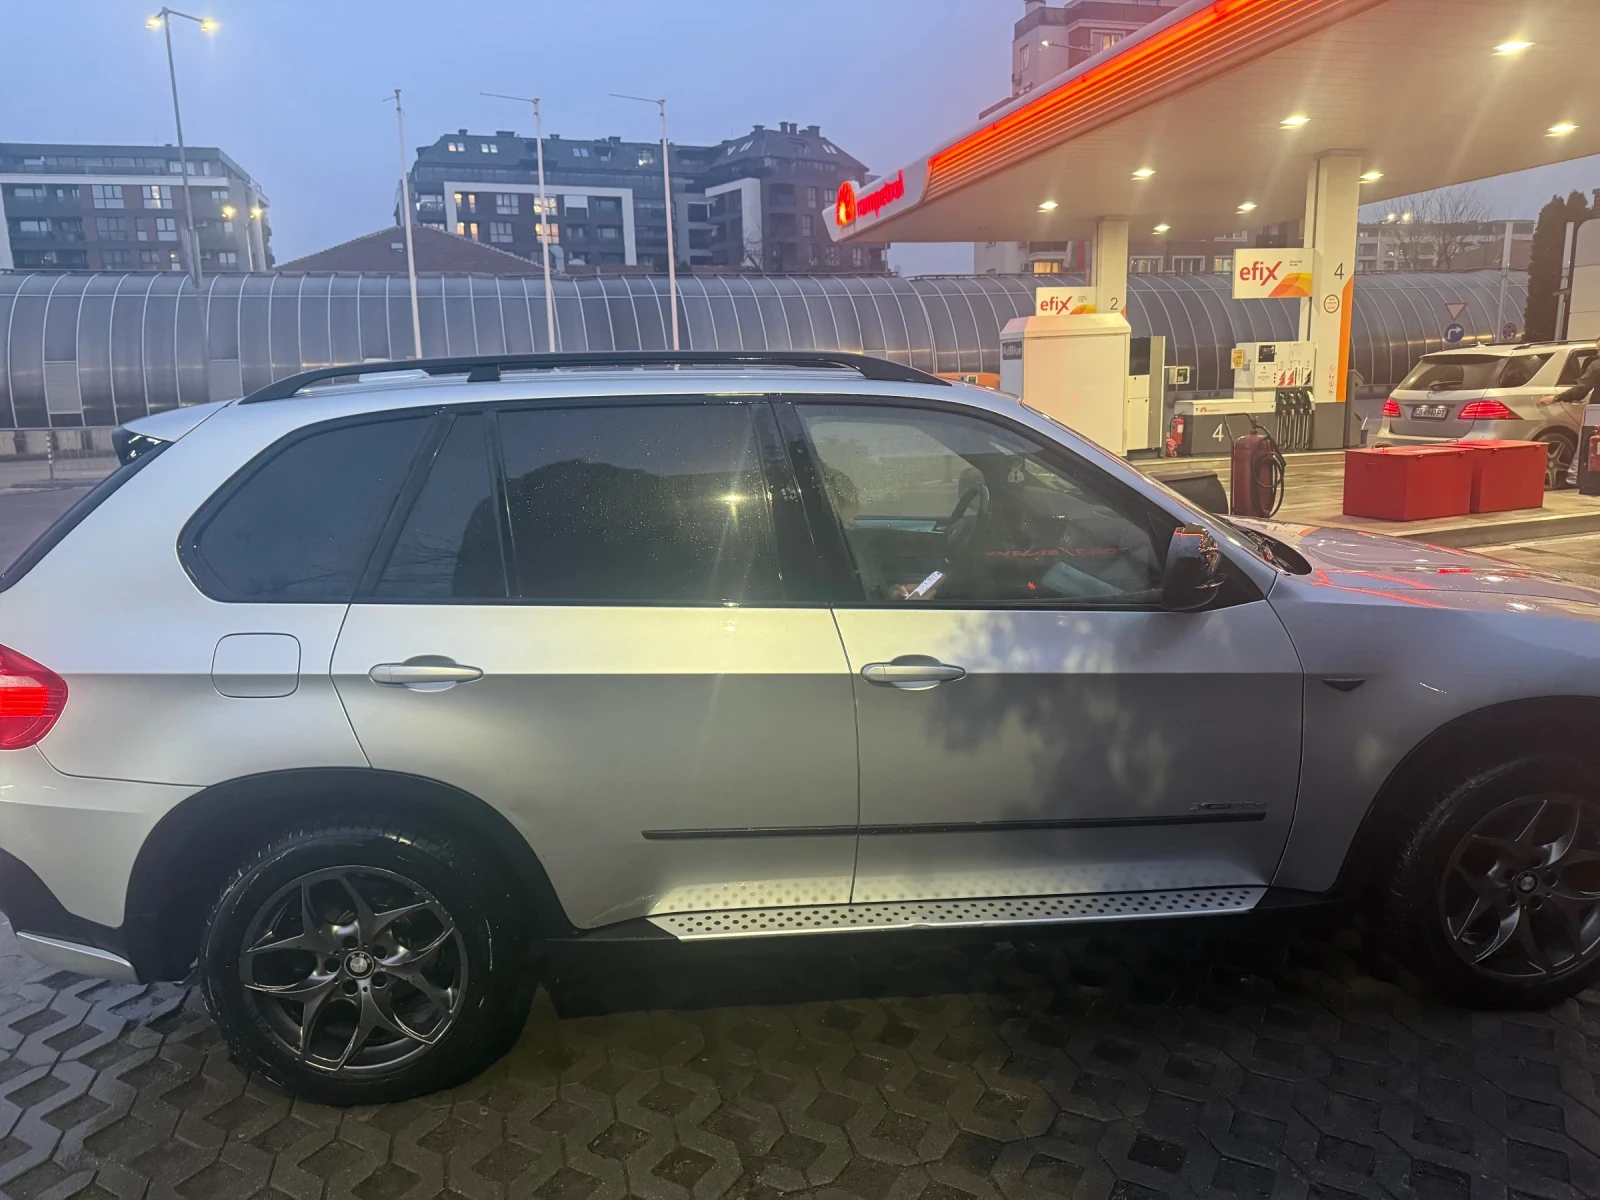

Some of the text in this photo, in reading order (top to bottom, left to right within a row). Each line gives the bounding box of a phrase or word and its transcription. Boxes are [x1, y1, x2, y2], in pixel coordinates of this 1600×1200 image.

[1239, 260, 1283, 286] efix
[1334, 262, 1344, 280] 4
[1040, 295, 1073, 315] efix
[1110, 296, 1118, 311] 2
[1002, 345, 1022, 356] AdBlue
[1212, 423, 1225, 442] 4
